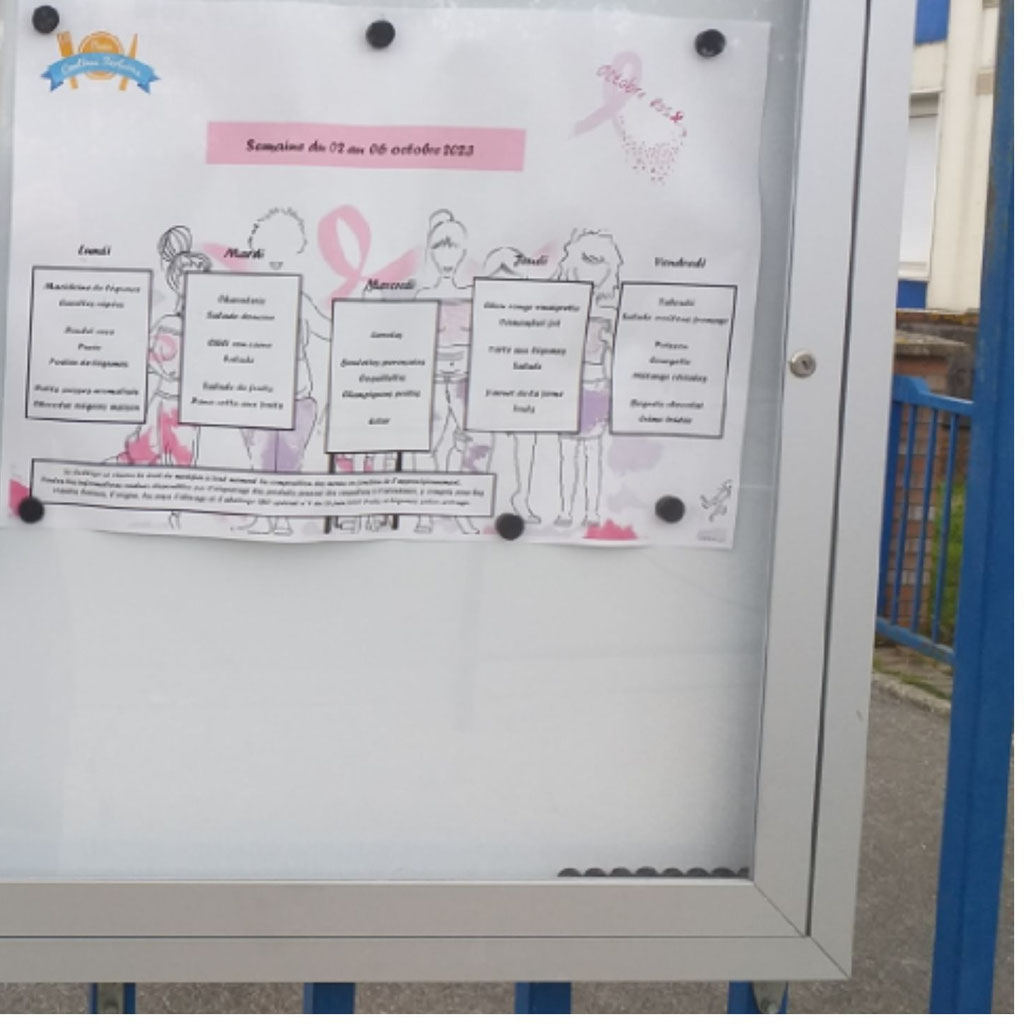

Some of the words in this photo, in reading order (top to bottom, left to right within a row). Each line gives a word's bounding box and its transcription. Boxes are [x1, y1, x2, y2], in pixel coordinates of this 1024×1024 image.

[246, 138, 305, 153] Semaine
[308, 139, 326, 153] du
[329, 141, 346, 154] 02
[347, 145, 365, 155] au
[369, 142, 388, 156] 06
[390, 142, 441, 156] octobre
[443, 144, 474, 157] 2023
[77, 244, 112, 256] Lundi
[223, 248, 265, 259] Mardi
[654, 257, 706, 269] Vendredi
